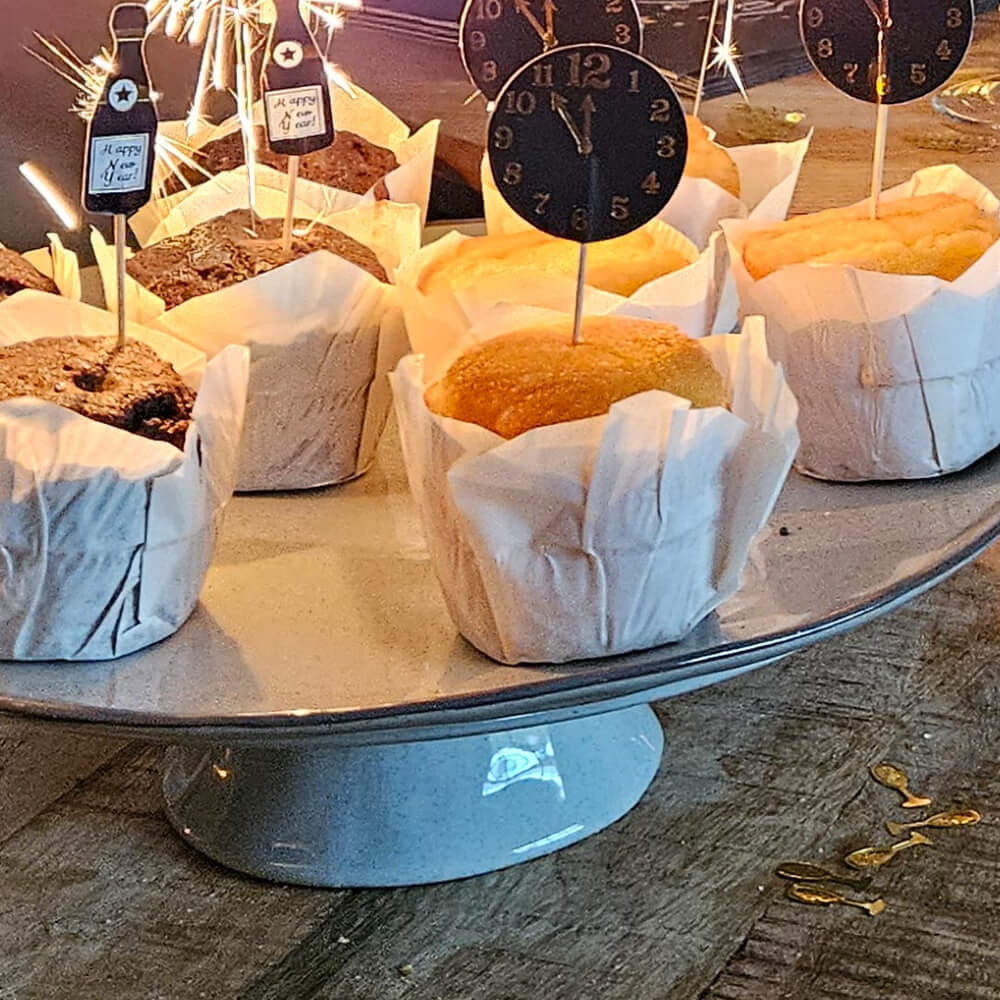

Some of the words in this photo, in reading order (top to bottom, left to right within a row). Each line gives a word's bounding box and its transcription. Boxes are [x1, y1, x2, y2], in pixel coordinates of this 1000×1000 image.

[476, 0, 501, 19] 10
[807, 7, 824, 28] 9
[947, 7, 963, 28] 3
[470, 31, 486, 50] 9
[615, 24, 631, 44] 3
[817, 38, 833, 58] 8
[935, 39, 952, 61] 4
[531, 63, 553, 87] 11
[566, 52, 611, 89] 12
[627, 69, 641, 93] 1
[843, 63, 859, 83] 7
[910, 63, 927, 85] 5
[505, 90, 536, 115] 10
[649, 98, 671, 123] 2
[494, 125, 513, 150] 9
[656, 135, 677, 159] 3
[103, 144, 142, 157] Happy
[502, 162, 523, 186] 8
[640, 170, 661, 195] 4
[532, 192, 551, 216] 7
[609, 195, 631, 221] 5
